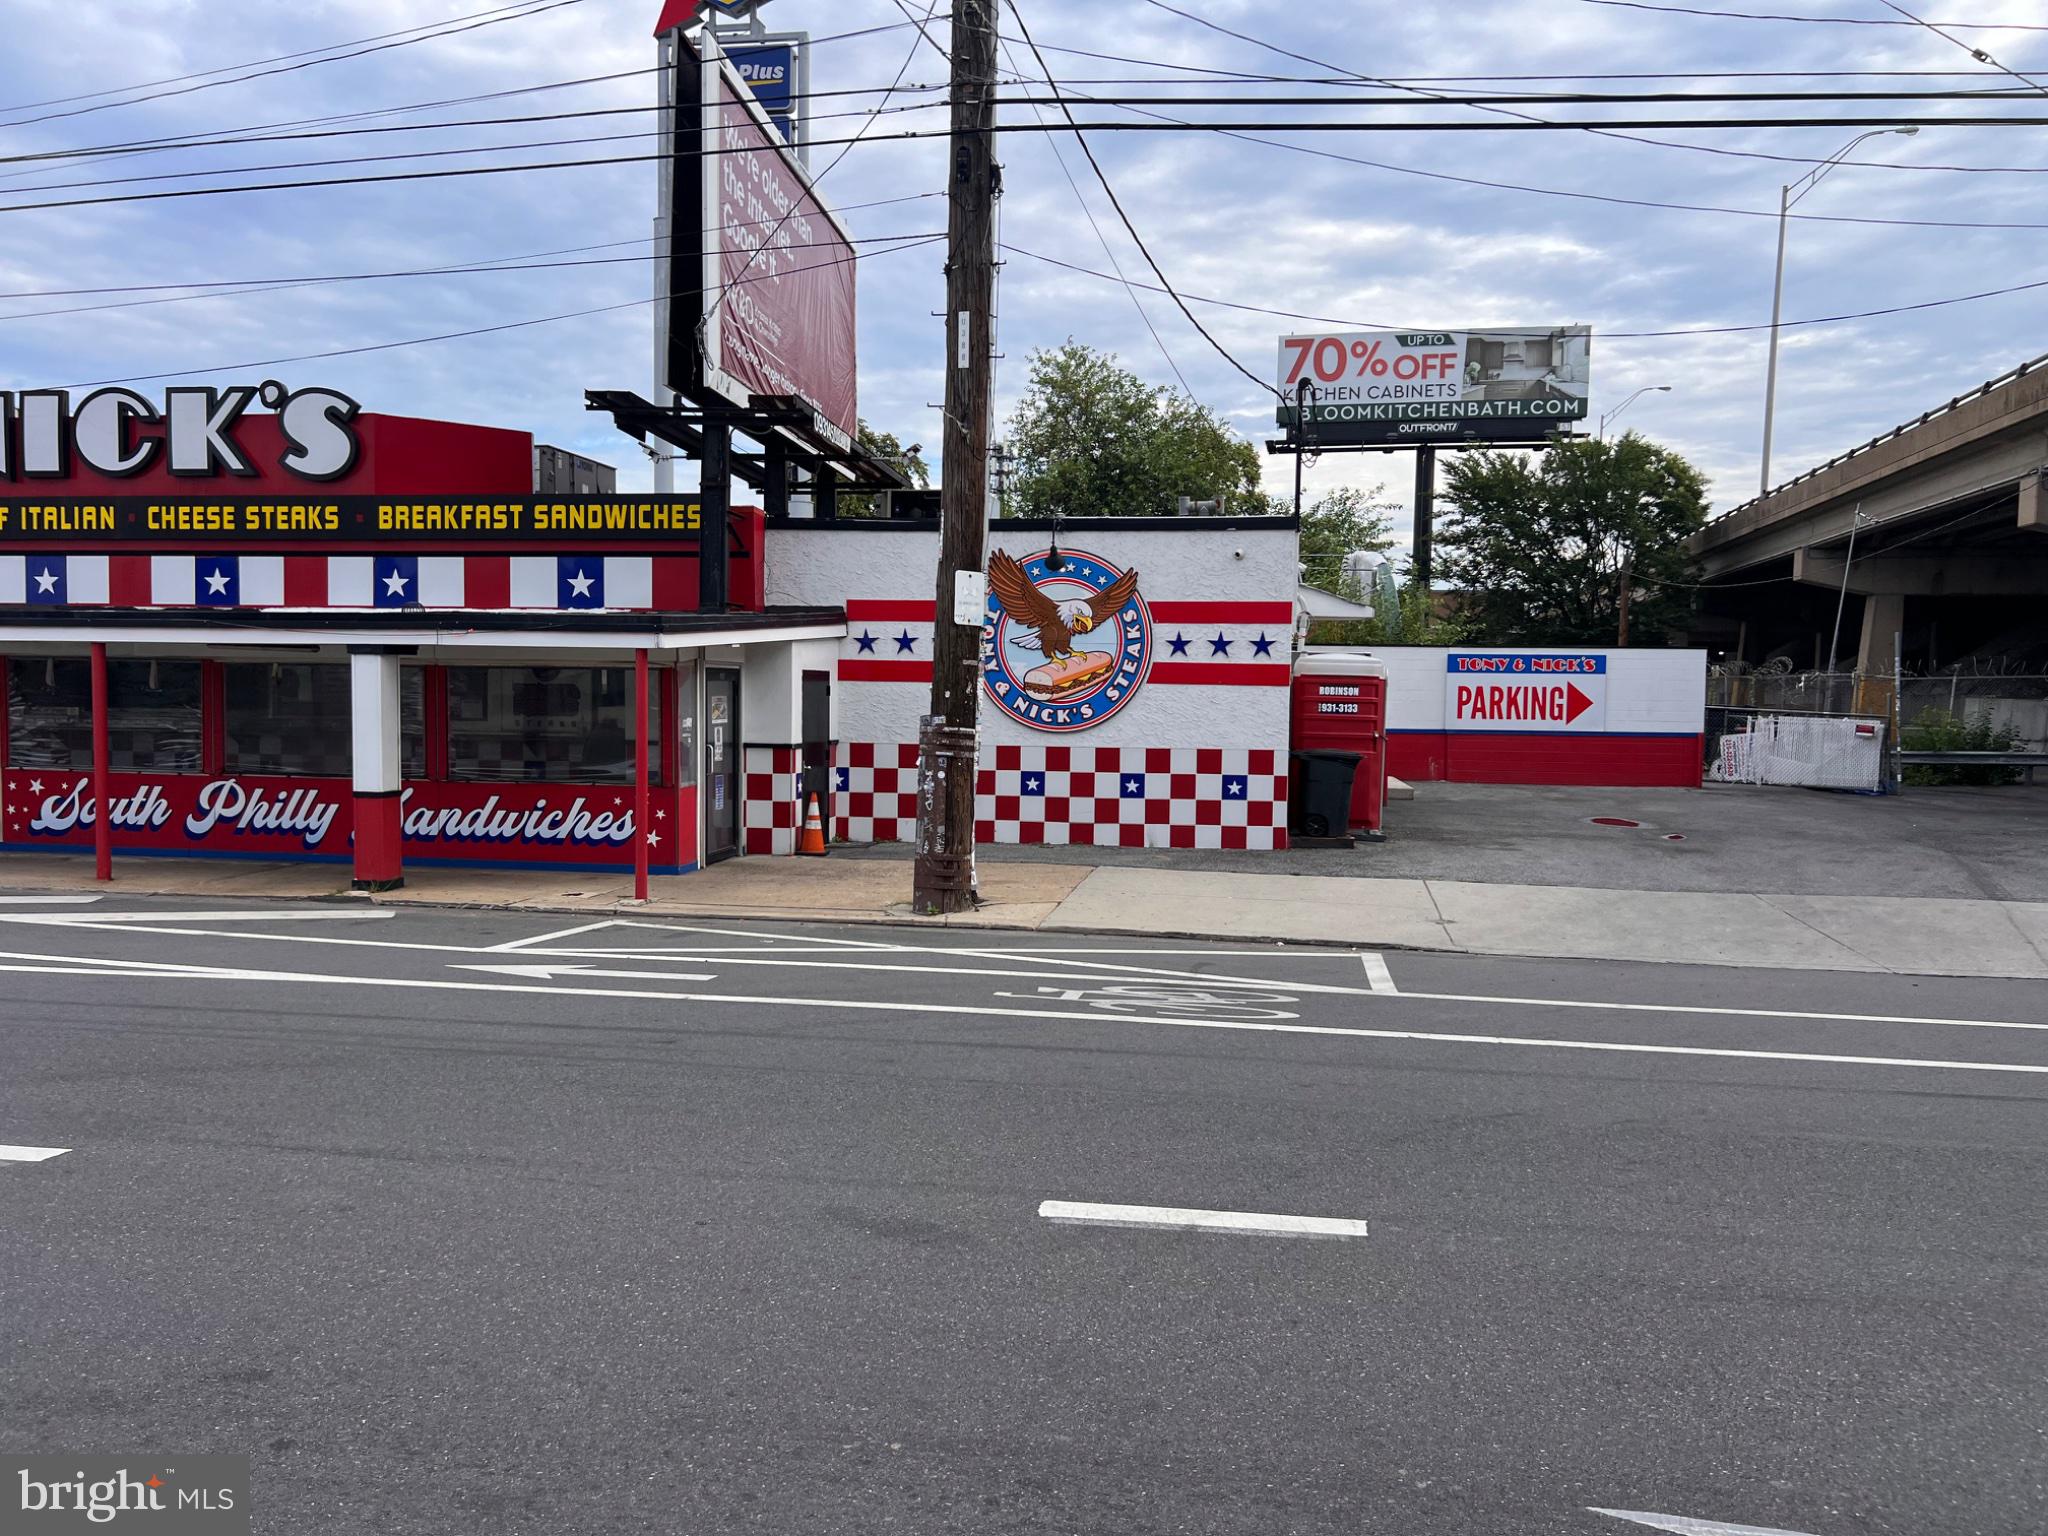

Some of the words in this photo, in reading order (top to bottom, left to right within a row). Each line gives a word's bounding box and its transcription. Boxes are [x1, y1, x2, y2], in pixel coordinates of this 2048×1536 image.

[738, 63, 785, 80] Plus
[723, 160, 745, 208] the
[761, 169, 789, 217] older
[723, 202, 767, 270] Google
[1284, 337, 1388, 385] 70%
[1393, 353, 1458, 380] OFF
[1407, 335, 1424, 346] UP
[1426, 334, 1444, 345] TO
[1367, 383, 1457, 399] CABINETS
[0, 380, 361, 481] ICK'S
[21, 506, 116, 530] ITALIAN
[147, 506, 236, 530] CHEESE
[245, 506, 339, 530] STEAKS
[378, 505, 524, 530] BREAKFAST
[533, 504, 701, 530] SANDWICHES
[995, 681, 1011, 699] &
[1012, 698, 1094, 724] NICK'S
[1105, 609, 1142, 702] STEAKS
[1456, 657, 1510, 671] TONY
[1512, 658, 1525, 672] &
[1531, 656, 1596, 672] NICK'S
[1319, 686, 1359, 697] ROBINSON
[1456, 685, 1564, 721] PARKING
[30, 777, 173, 832] South
[186, 778, 340, 844] Philly
